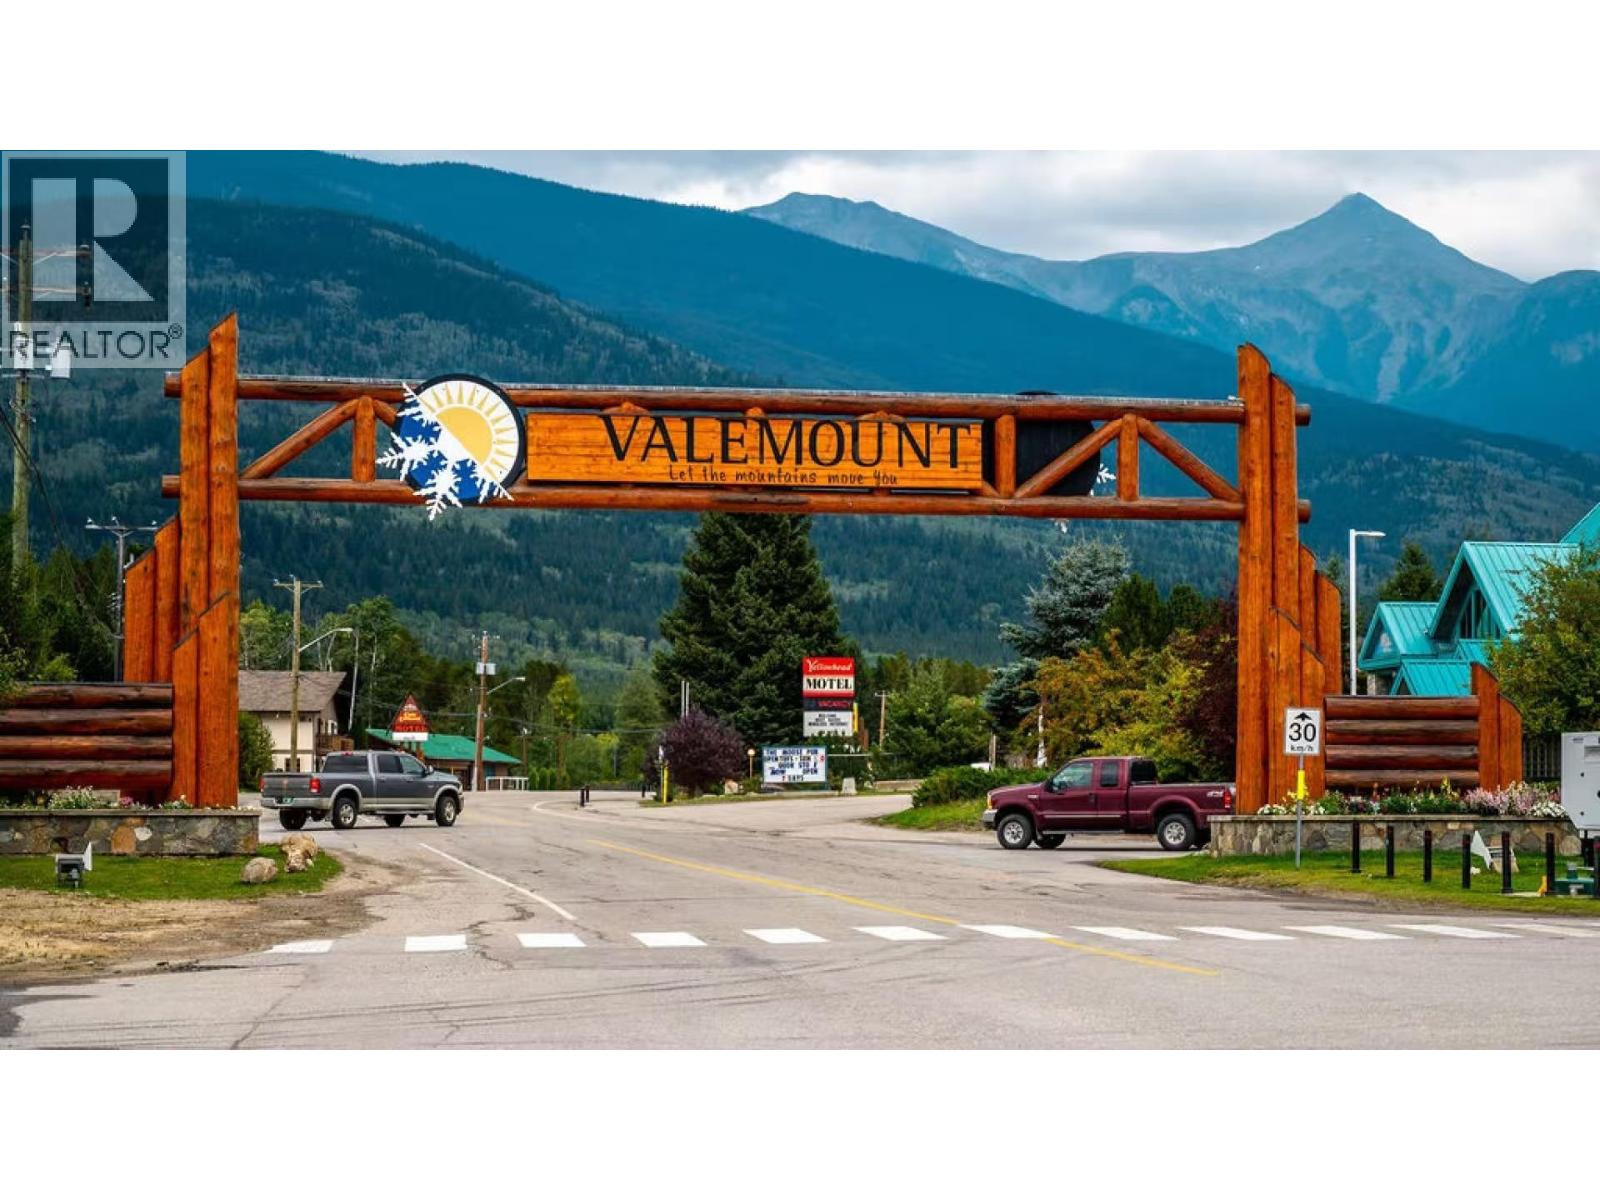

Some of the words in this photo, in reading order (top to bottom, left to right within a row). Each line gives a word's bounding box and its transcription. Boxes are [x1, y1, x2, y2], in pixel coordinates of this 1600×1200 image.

[599, 415, 971, 468] VALEMOUNT
[668, 464, 693, 481] Let
[703, 465, 726, 482] the
[736, 467, 817, 484] mountains
[827, 473, 864, 485] move
[806, 678, 852, 689] MOTEL
[1289, 722, 1317, 742] 30
